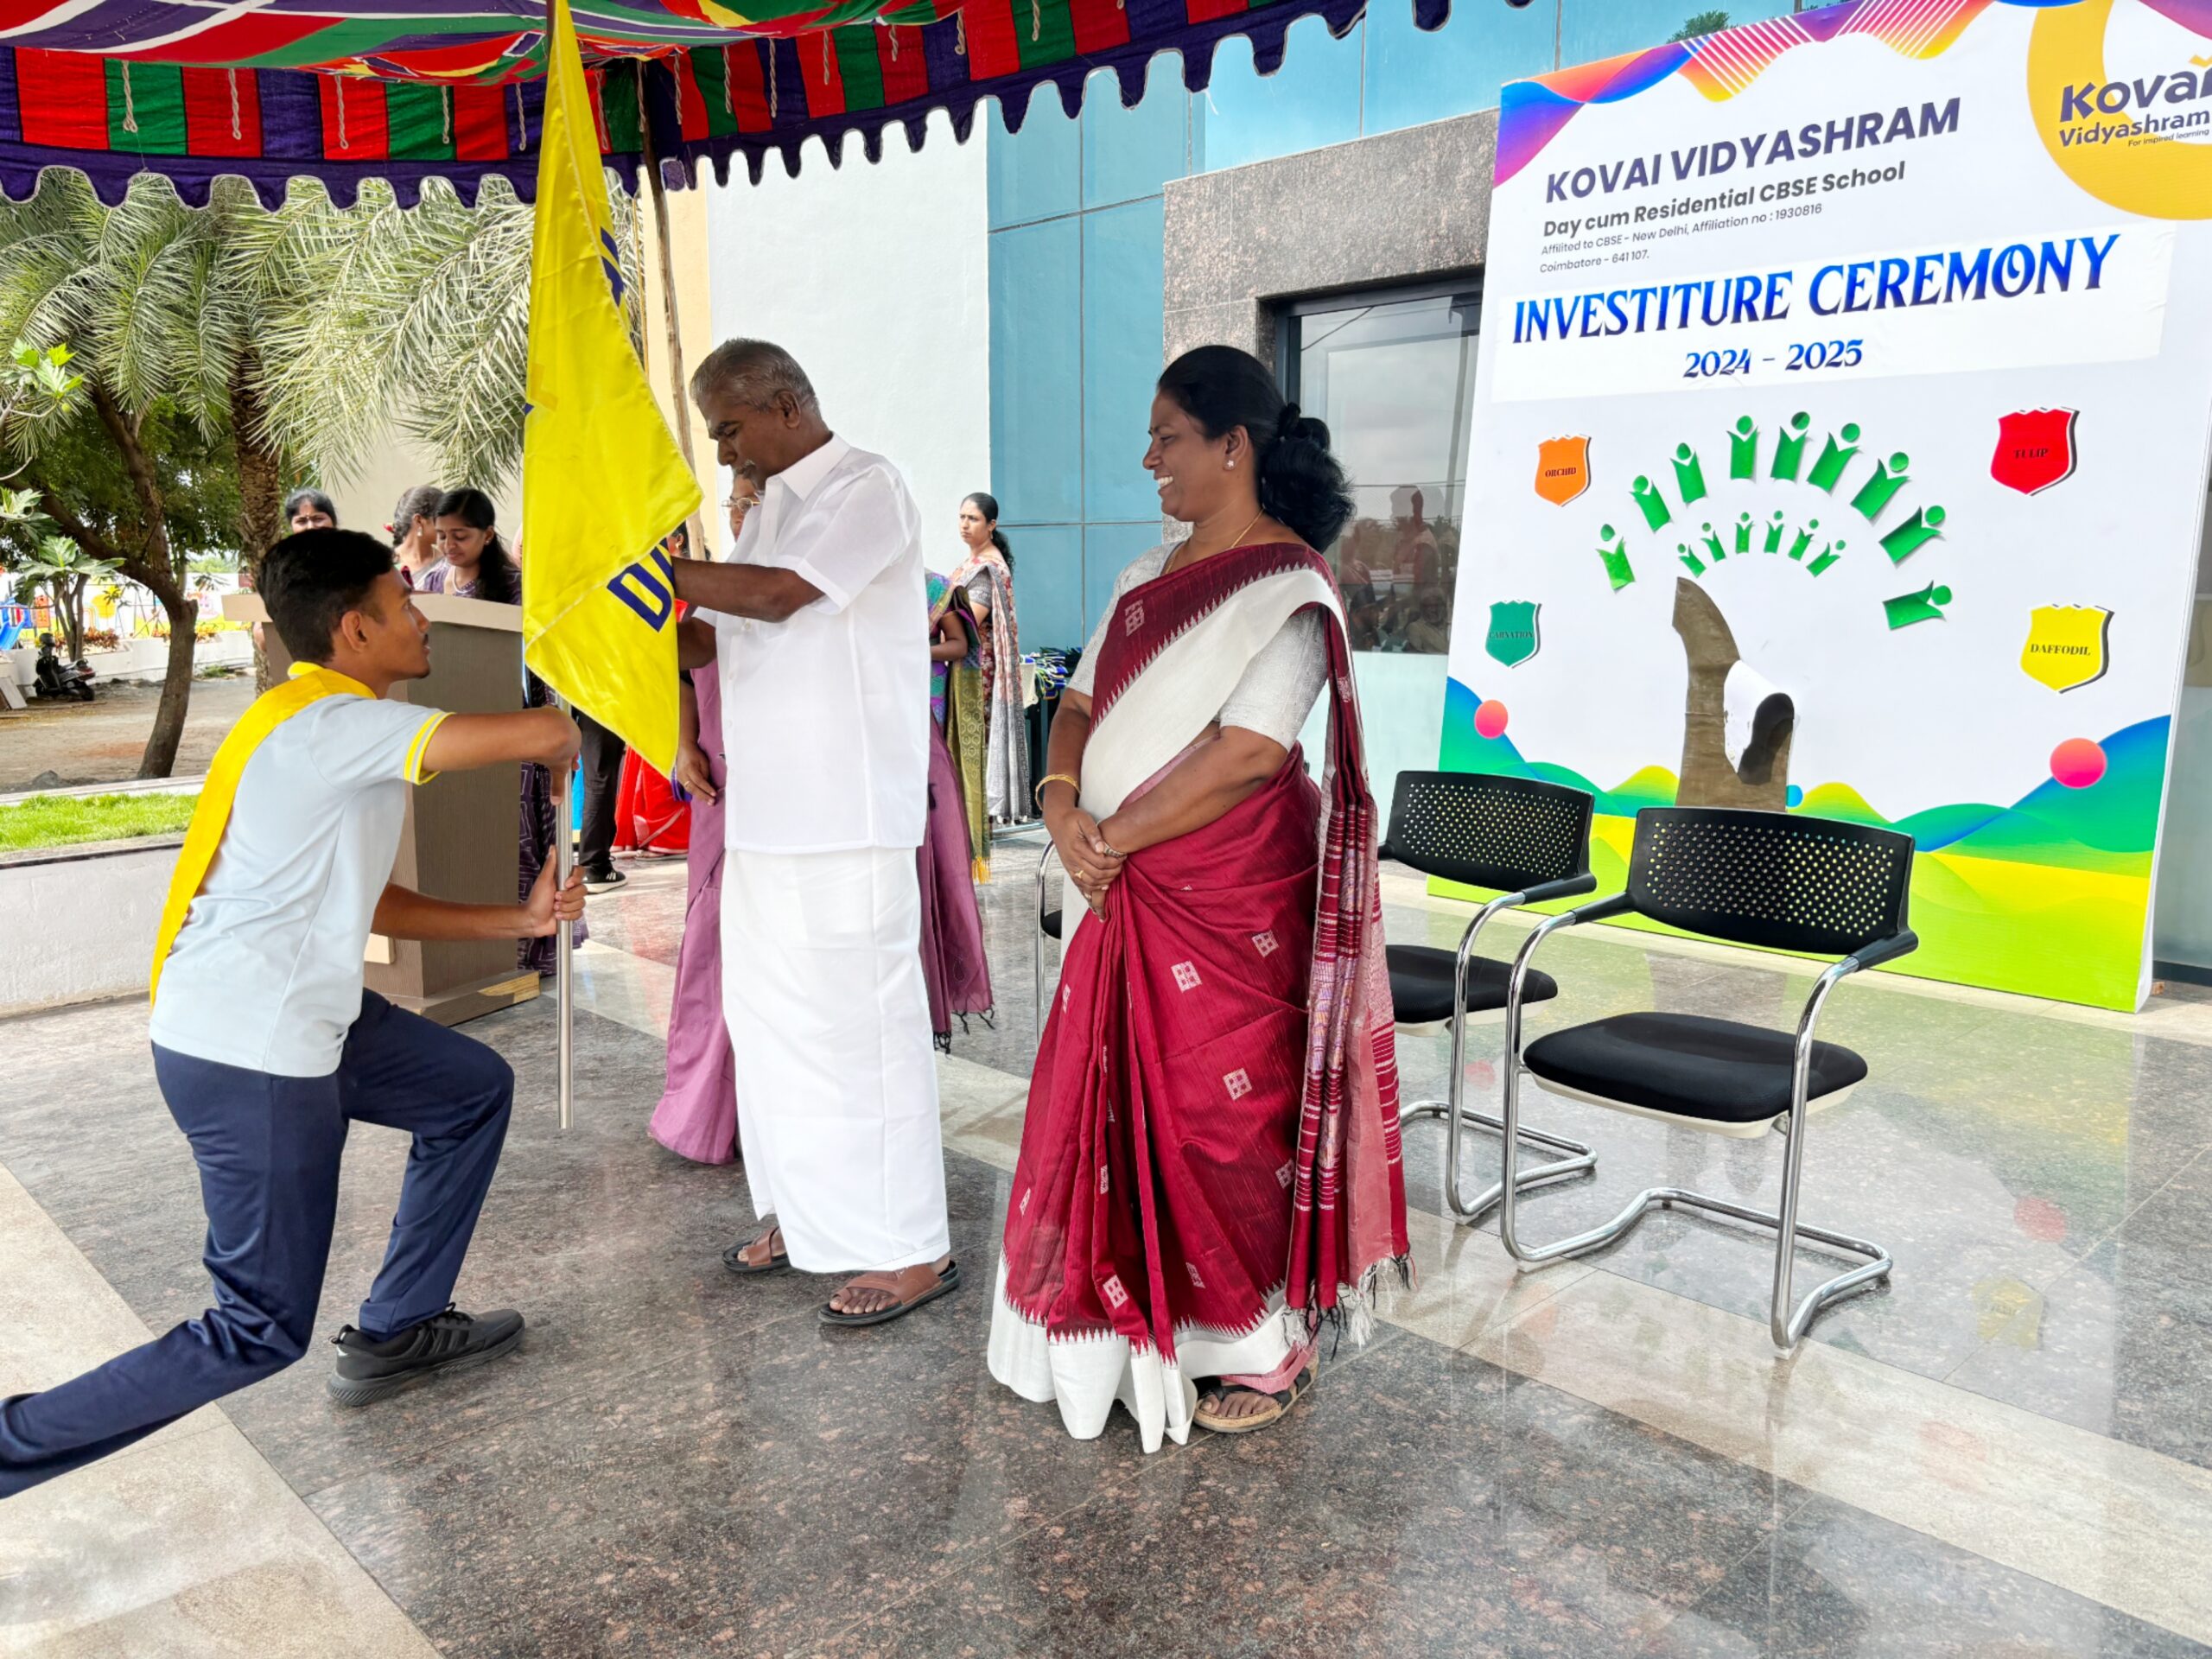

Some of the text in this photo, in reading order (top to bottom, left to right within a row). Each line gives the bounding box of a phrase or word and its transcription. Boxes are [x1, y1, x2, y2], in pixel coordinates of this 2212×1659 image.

[2059, 110, 2210, 147] Vidyashram
[2127, 129, 2210, 147] For inspired learning
[1546, 97, 1960, 203] KOVAI VIDYASHRAM
[1543, 161, 1905, 238] Day cum Residential CBSE School
[1541, 239, 1580, 255] Affilited
[1583, 237, 1593, 249] to
[1596, 234, 1623, 248] CBSE
[1632, 230, 1656, 243] New
[1659, 223, 1689, 238] Delhi,
[1692, 215, 1749, 234] Affiliation
[1751, 213, 1766, 225] no
[1775, 203, 1822, 220] 1930816
[1540, 256, 1601, 273] Coimbatore
[1513, 234, 2121, 344] INVESTITURE CEREMONY
[1683, 348, 1751, 378] 2024
[1785, 340, 1863, 371] 2025
[2031, 644, 2091, 656] DAFFODIL
